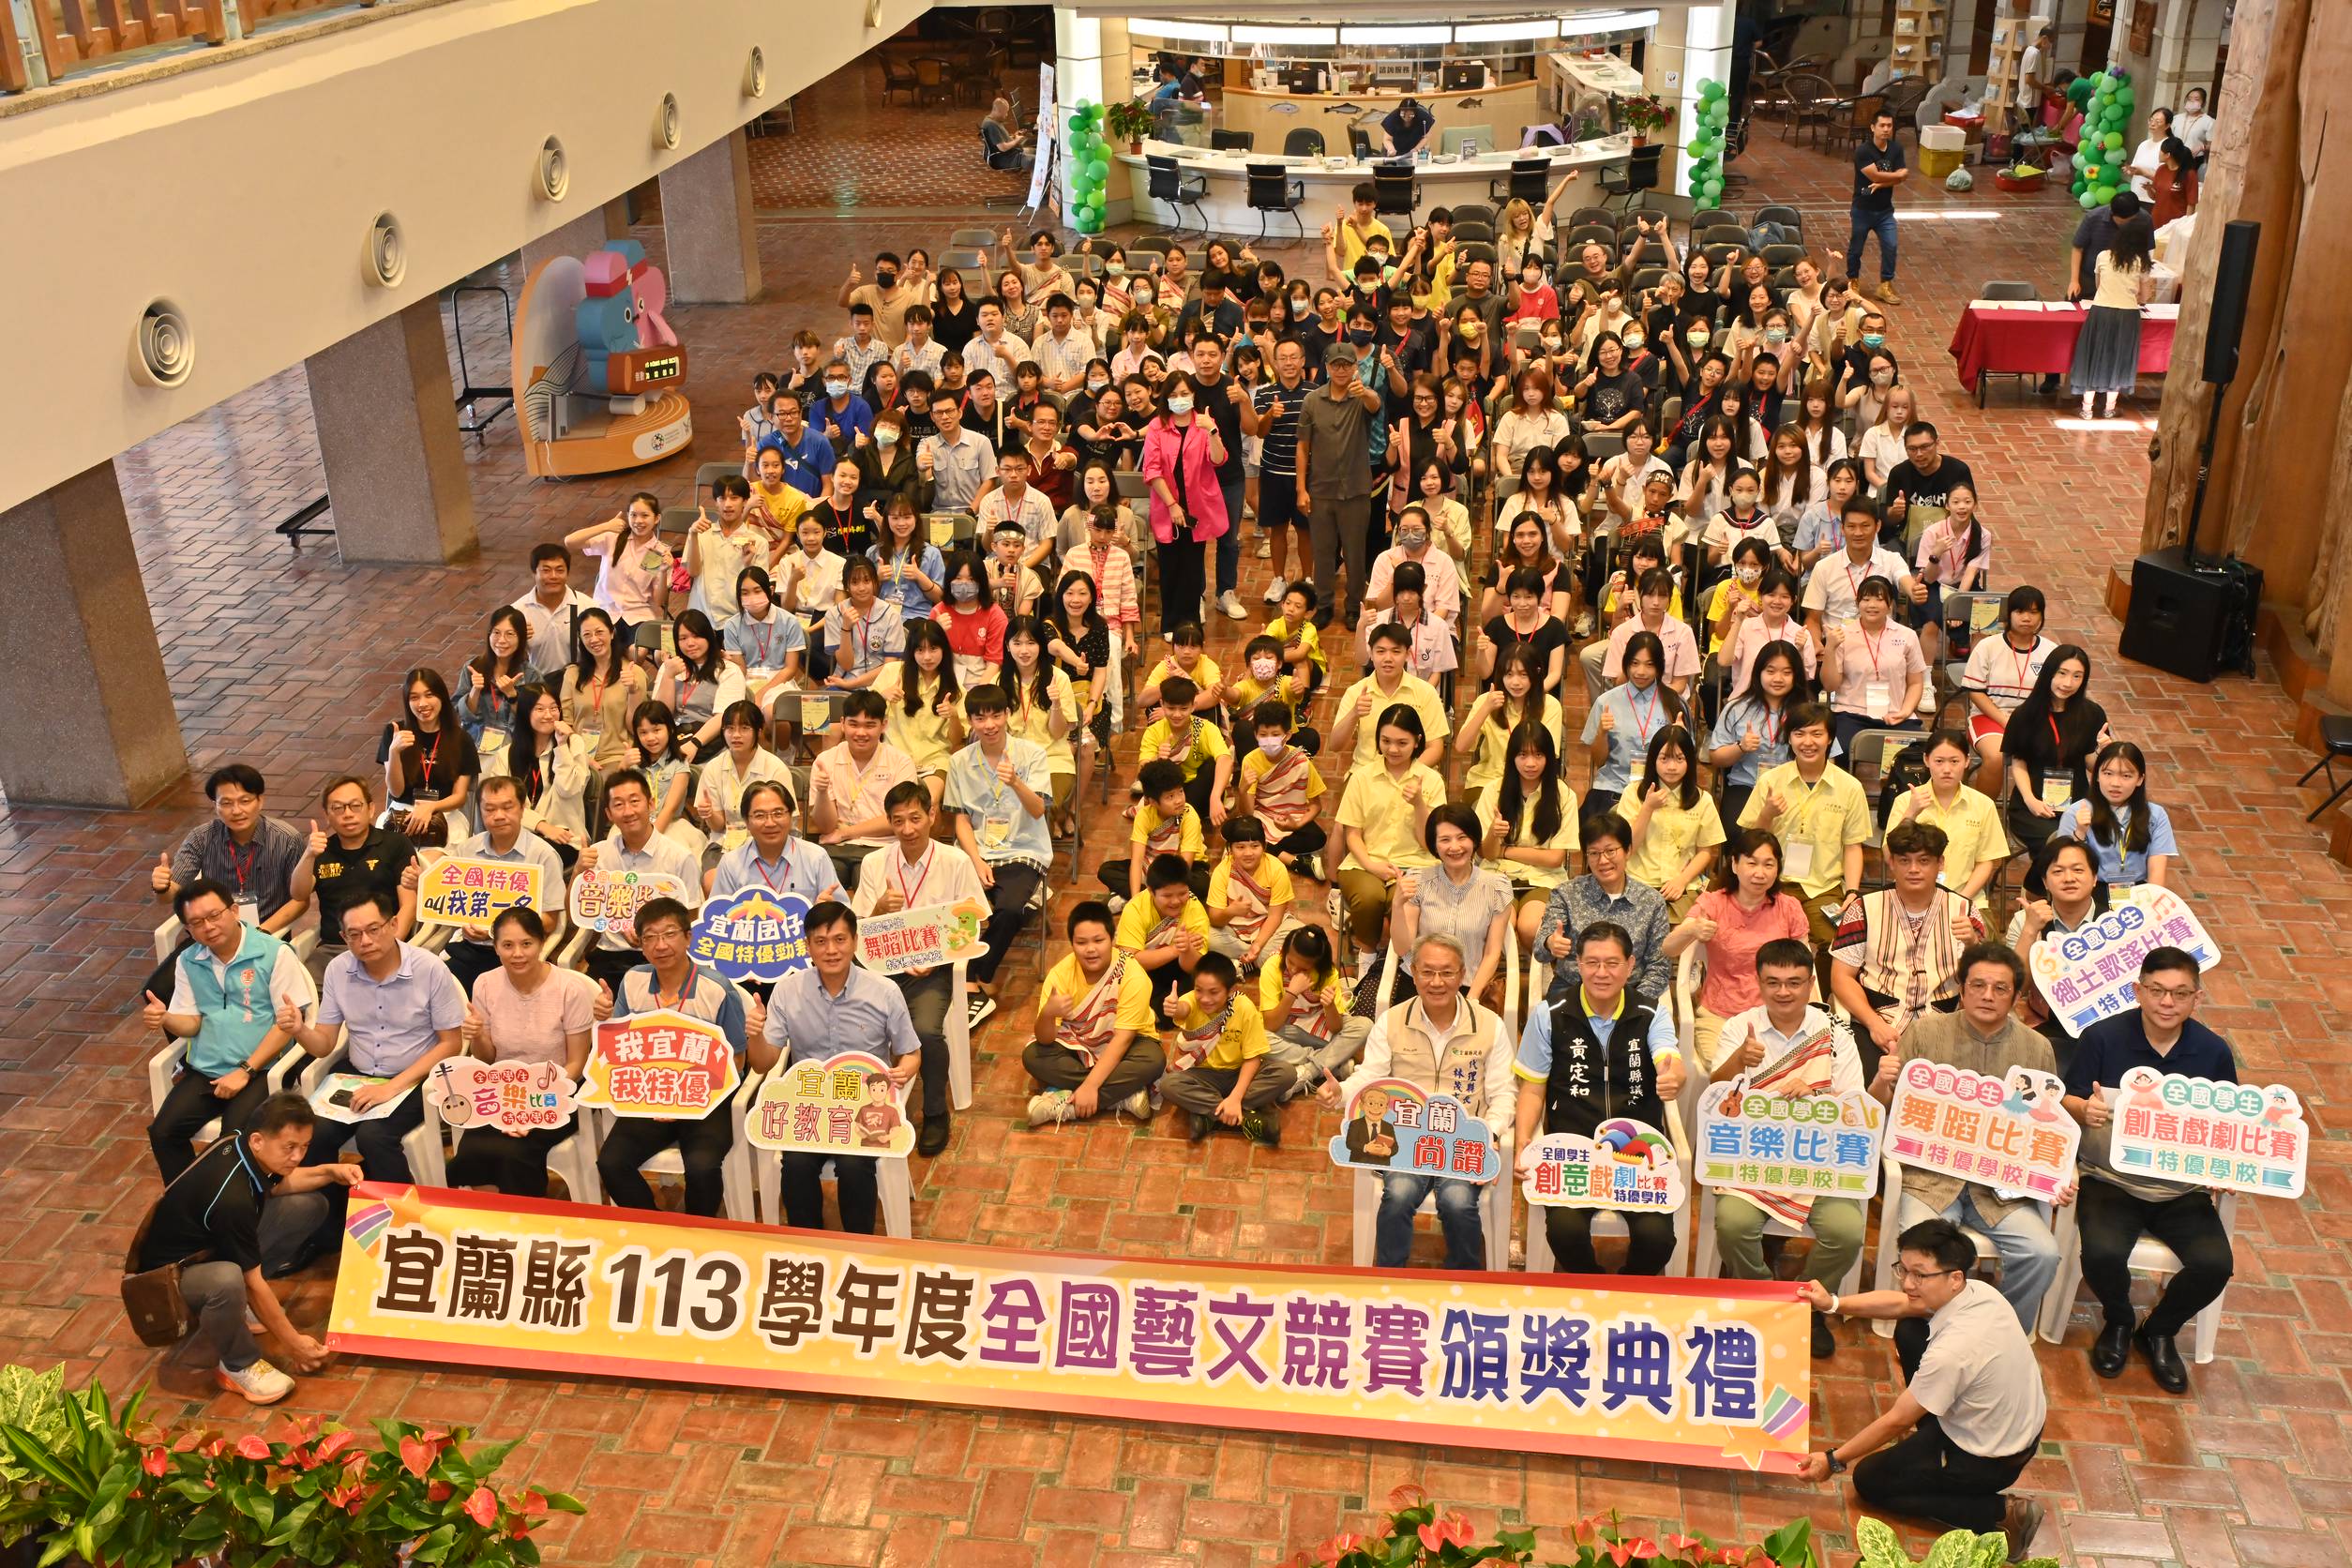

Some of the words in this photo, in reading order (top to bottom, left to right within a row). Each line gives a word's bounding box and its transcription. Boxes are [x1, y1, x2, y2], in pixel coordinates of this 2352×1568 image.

[441, 864, 530, 892] 全國特優
[578, 883, 655, 919] 音樂比
[705, 912, 804, 942] 宜蘭囝仔
[863, 924, 940, 960] 舞蹈比賽
[2064, 906, 2144, 960] 全國學生
[2051, 915, 2195, 1007] 鄉土歌謠比賽
[614, 1030, 713, 1065] 我宜蘭
[474, 1069, 529, 1083] 全國學生
[795, 1067, 862, 1101] 宜蘭
[1569, 1037, 1590, 1098] 黃定和
[473, 1084, 558, 1116] 音樂比賽
[611, 1067, 710, 1106] 我特優
[1909, 1066, 2002, 1106] 全國學生
[2165, 1081, 2261, 1116] 全國學生
[761, 1100, 854, 1144] 好教育
[1393, 1099, 1457, 1134] 宜蘭
[1745, 1097, 1835, 1122] 全國學生
[1708, 1123, 1871, 1168] 音樂比賽
[1899, 1093, 2068, 1168] 舞蹈比賽
[2122, 1107, 2298, 1161] 創意戲劇比賽
[1412, 1135, 1486, 1176] 尚讚
[1542, 1147, 1591, 1163] 全國學生
[1926, 1142, 2025, 1186] 特優學校
[2157, 1149, 2259, 1184] 特優學校
[1534, 1161, 1667, 1199] 創意戲劇比賽
[1738, 1163, 1835, 1189] 特優學校
[1613, 1189, 1667, 1205] 特優學校
[375, 1229, 1758, 1421] 宜蘭縣113學年度全國藝文競賽頒獎典禮
